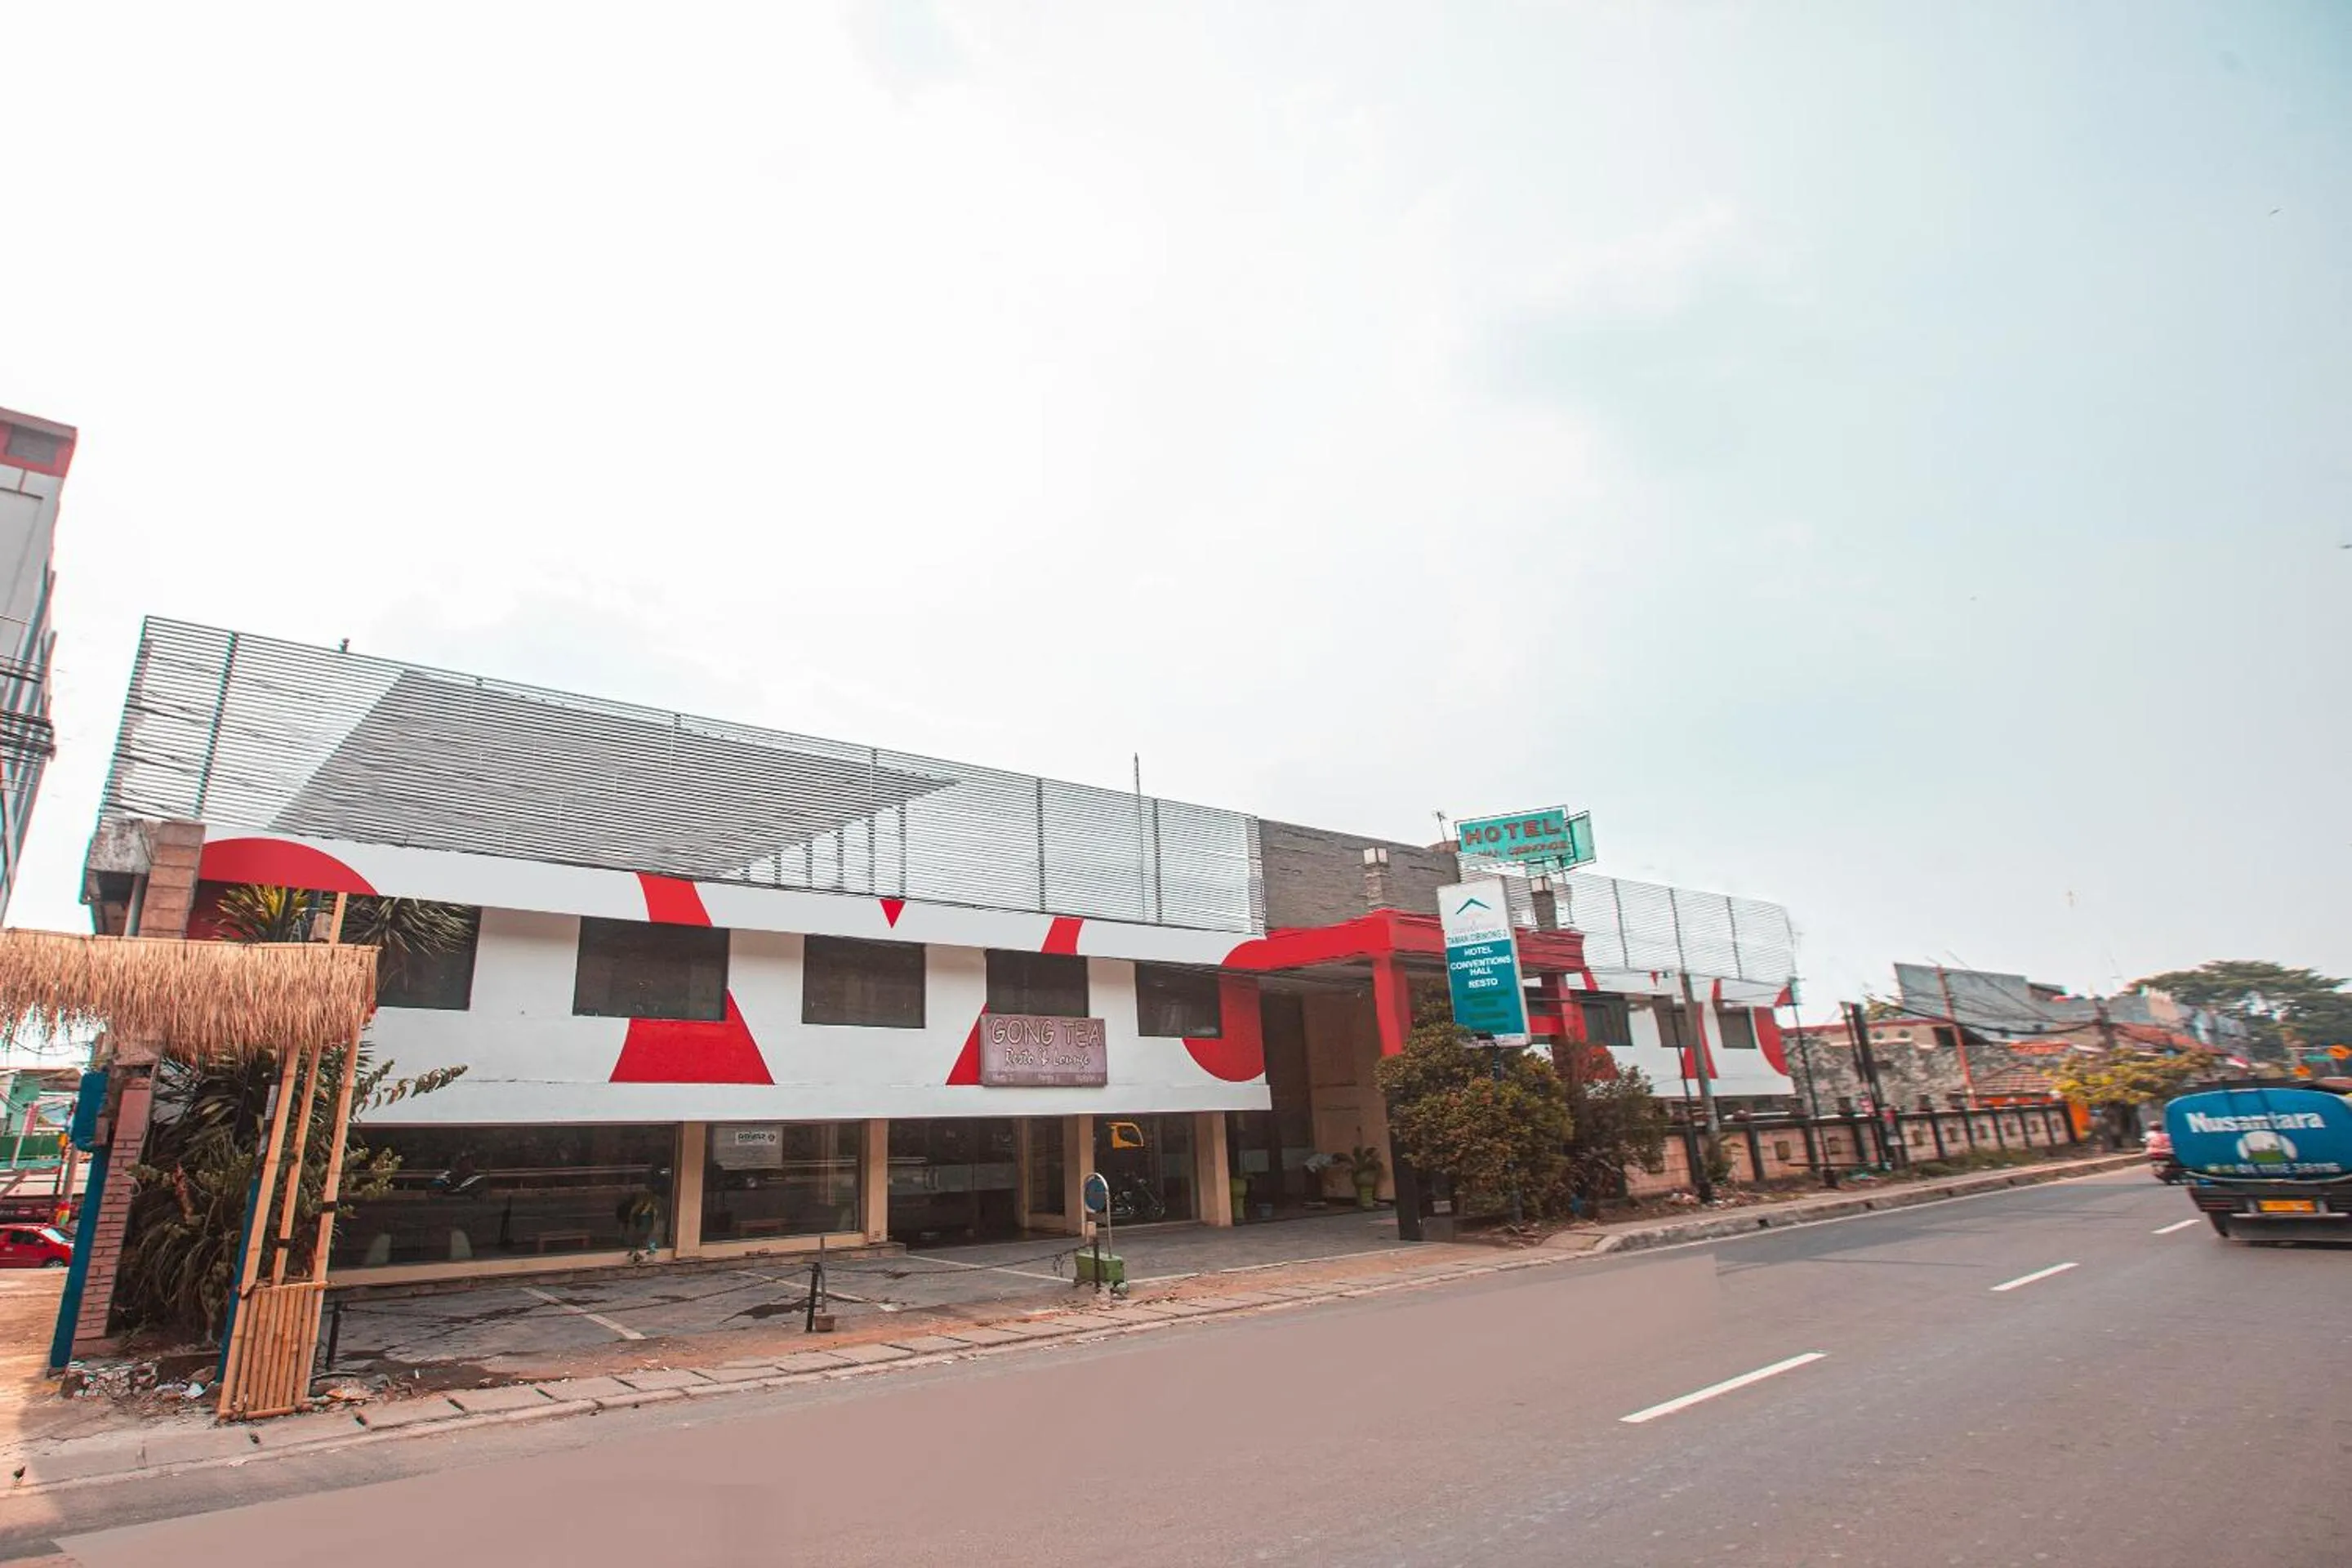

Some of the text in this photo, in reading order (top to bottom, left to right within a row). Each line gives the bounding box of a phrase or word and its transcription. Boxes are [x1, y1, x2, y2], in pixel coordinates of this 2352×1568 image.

[1464, 818, 1561, 845] HOTEL
[1463, 946, 1494, 956] HOTEL
[1450, 955, 1512, 970] CONVENTIONS
[1469, 967, 1493, 976] HALL
[1468, 978, 1499, 988] RESTO
[991, 1018, 1101, 1048] GONG TEA
[2185, 1111, 2327, 1133] Nusantara
